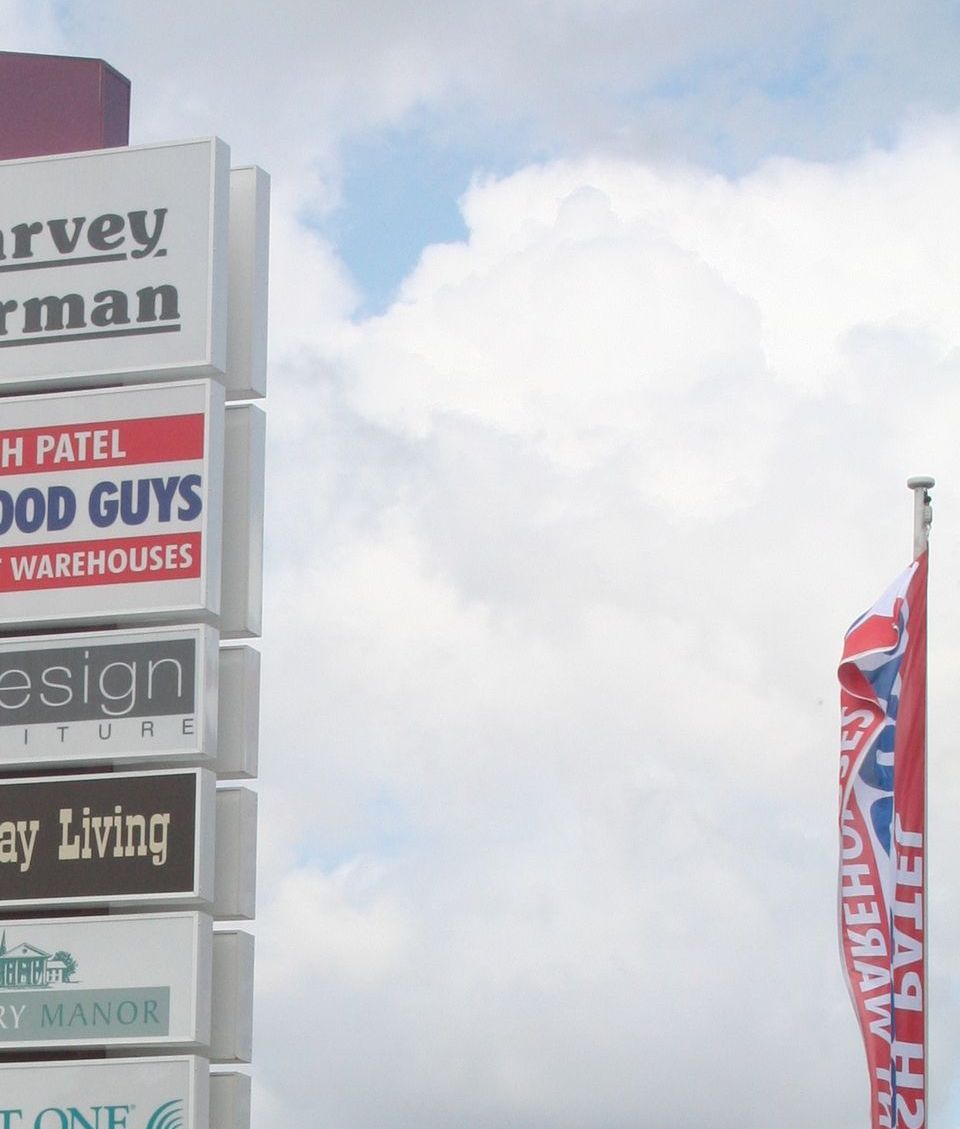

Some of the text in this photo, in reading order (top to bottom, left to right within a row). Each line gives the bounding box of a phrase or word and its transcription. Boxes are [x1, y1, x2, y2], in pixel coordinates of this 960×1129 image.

[36, 429, 126, 466] PATEL
[88, 474, 202, 529] GUYS
[10, 543, 194, 582] WAREHOUSES
[59, 805, 171, 866] Living
[41, 999, 161, 1028] MANOR
